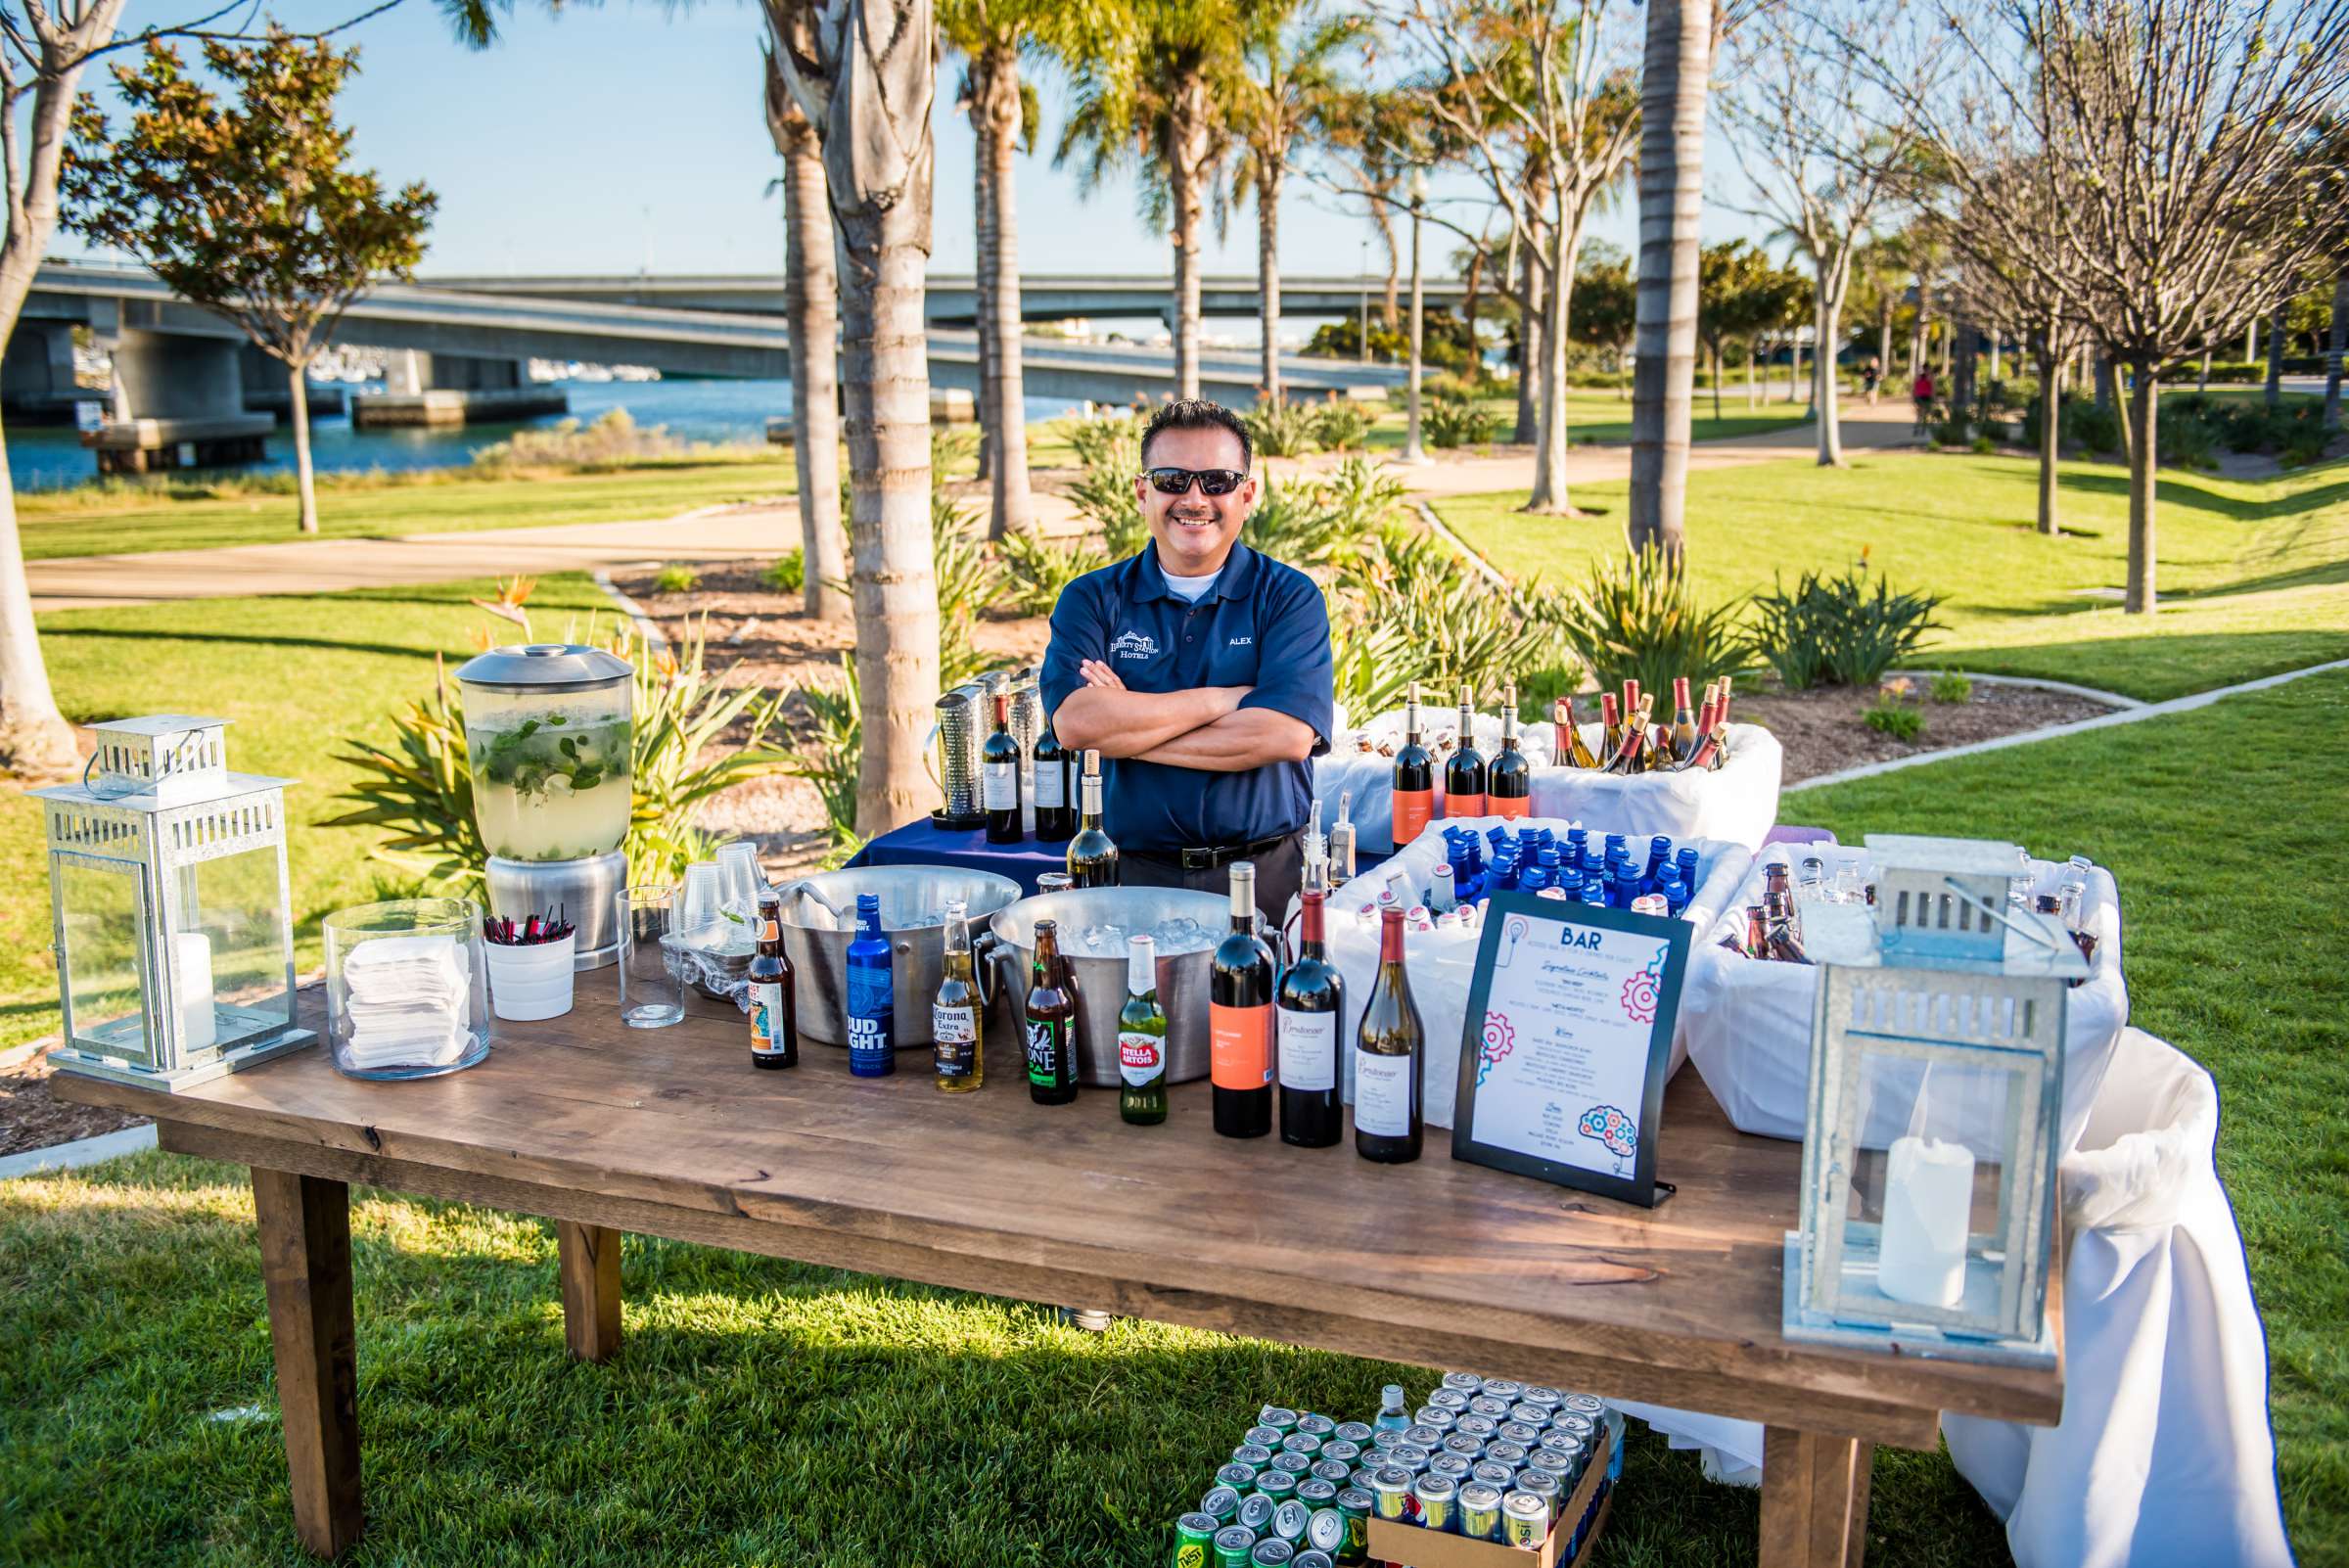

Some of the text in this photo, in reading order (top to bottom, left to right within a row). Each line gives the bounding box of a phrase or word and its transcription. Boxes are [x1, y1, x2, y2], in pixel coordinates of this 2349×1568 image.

[1229, 636, 1252, 645] ALEX
[1560, 926, 1602, 951] BAR
[933, 1006, 967, 1021] Corona
[848, 1015, 878, 1035] UD
[938, 1020, 959, 1031] Extra
[848, 1032, 888, 1050] GHT
[1028, 1047, 1056, 1071] ONE
